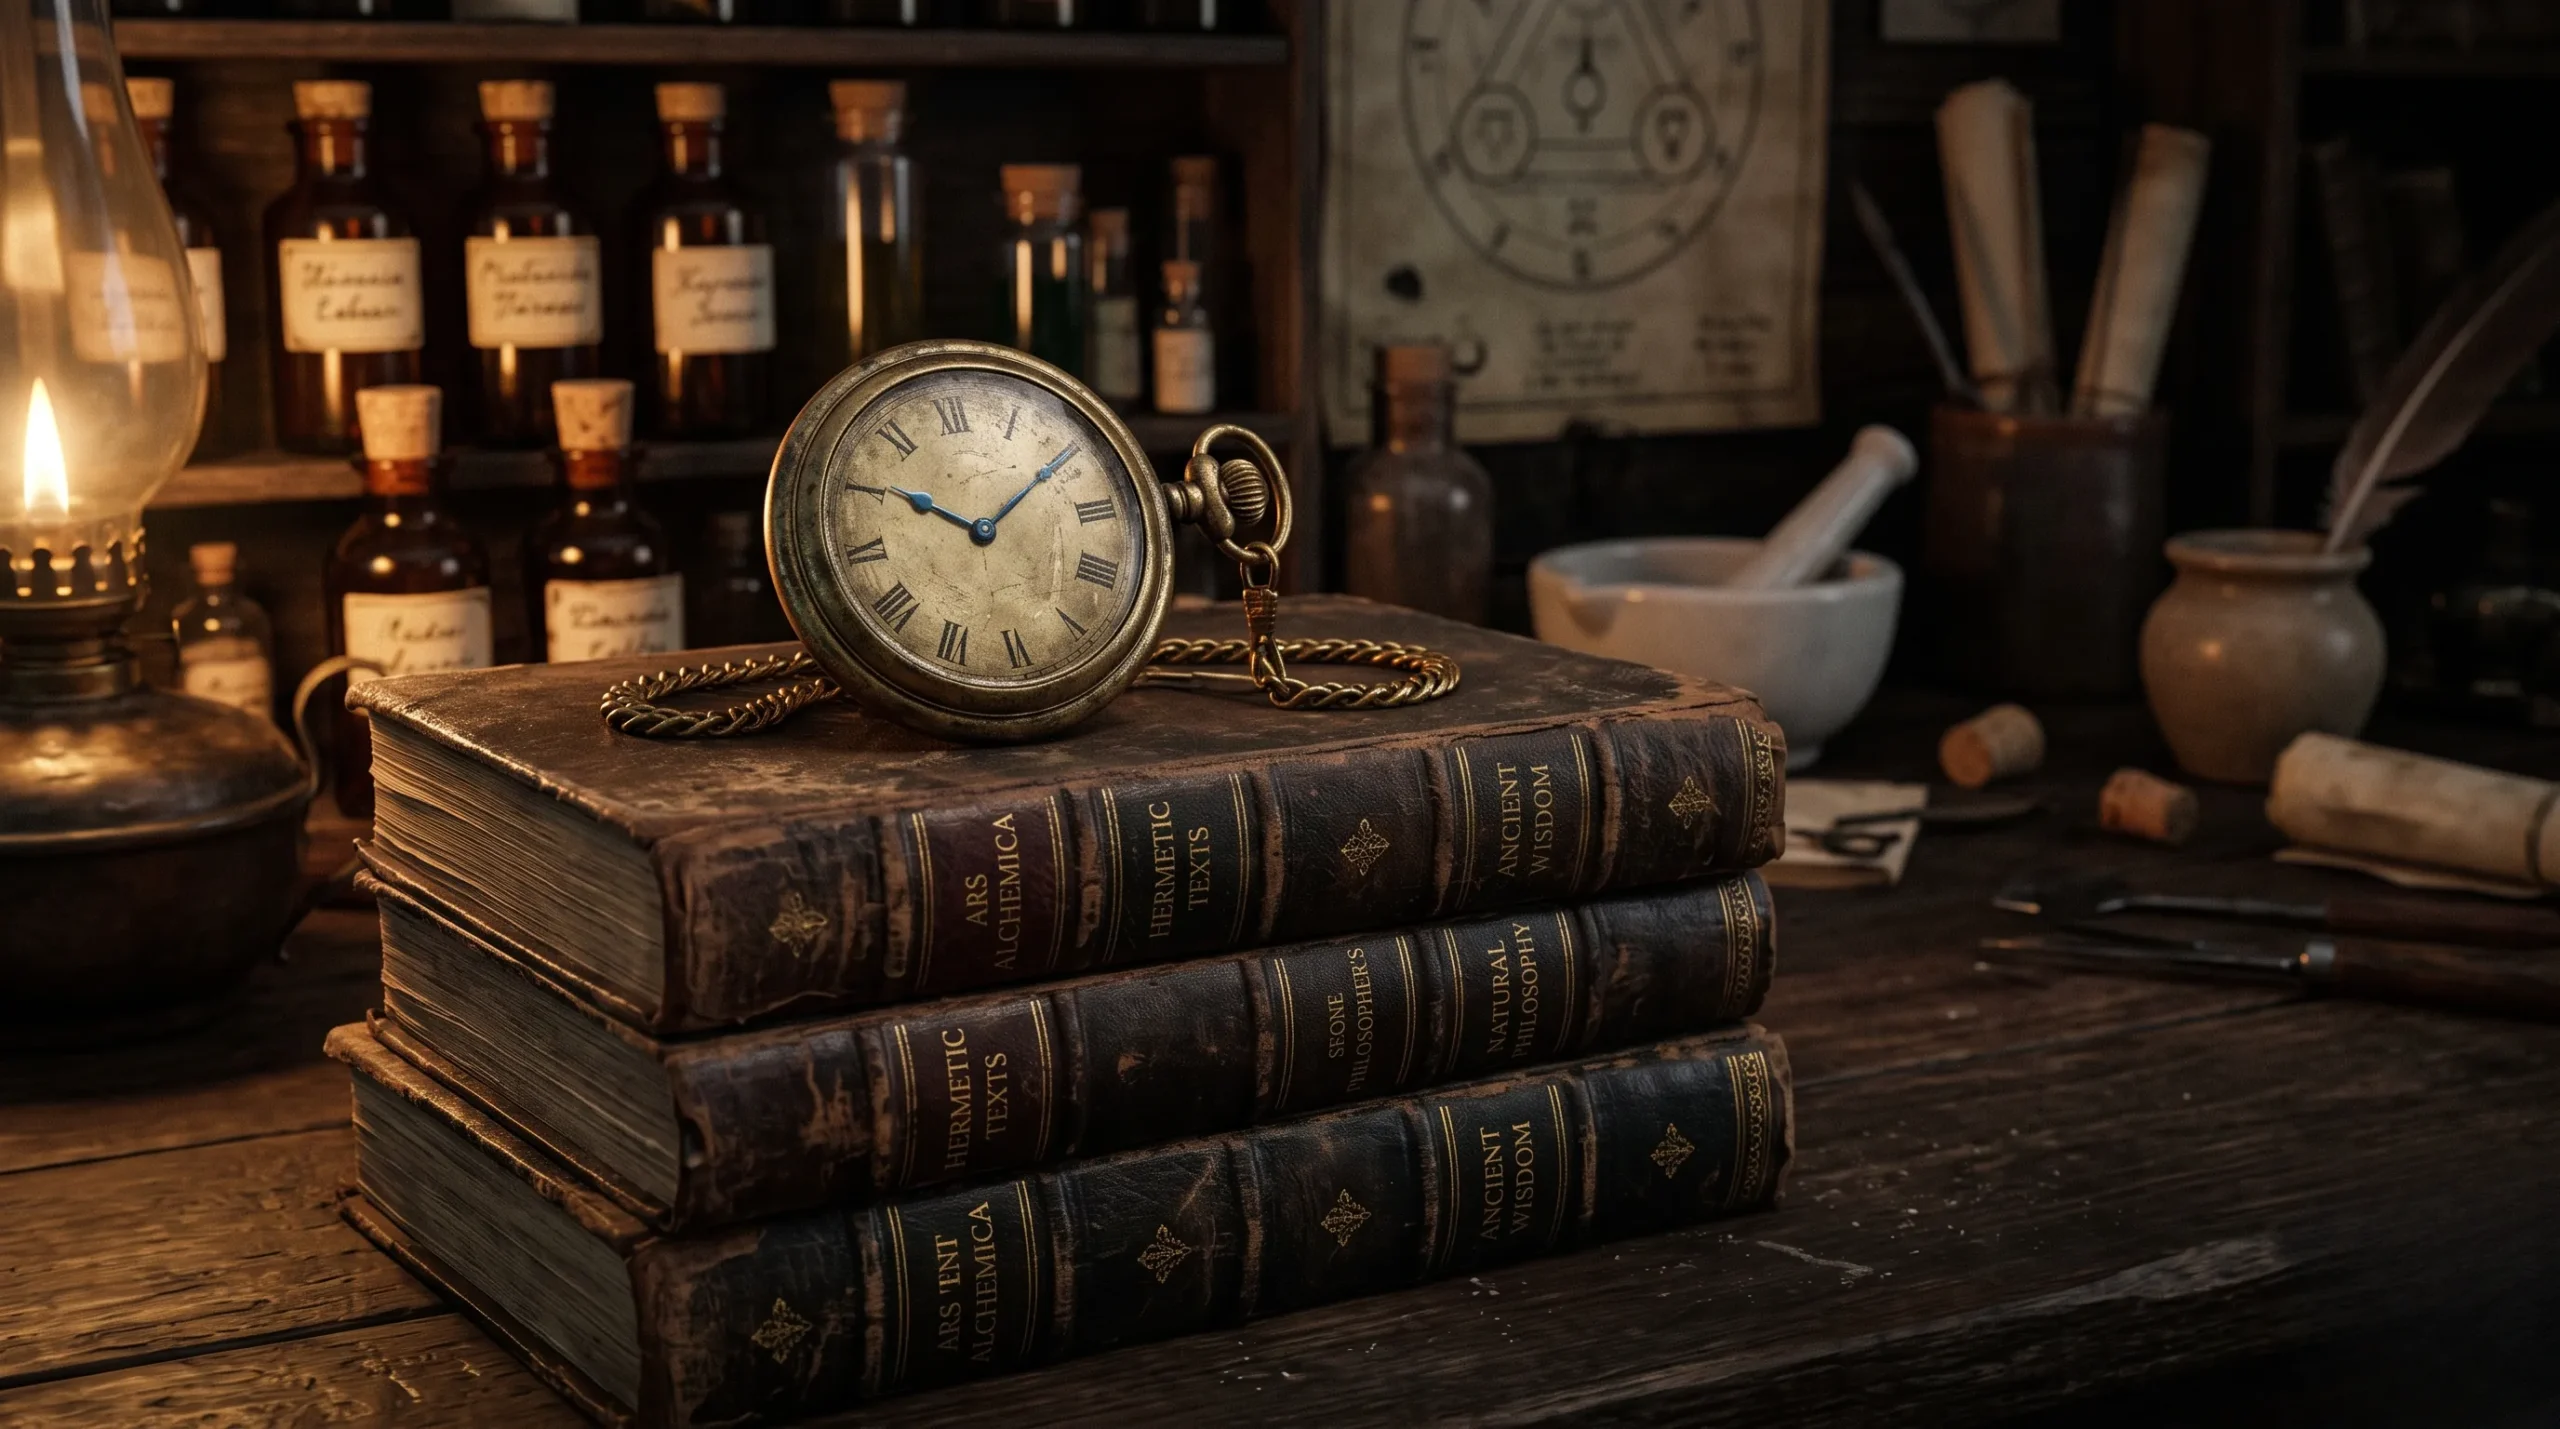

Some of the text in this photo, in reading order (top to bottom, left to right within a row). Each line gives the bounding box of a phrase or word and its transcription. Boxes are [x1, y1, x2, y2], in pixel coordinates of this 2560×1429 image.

[875, 419, 918, 462] XI
[930, 396, 972, 436] XII
[1003, 404, 1021, 441] I
[844, 476, 887, 506] X
[1074, 495, 1117, 527] III
[844, 535, 889, 567] IX
[1074, 549, 1119, 592] IIII
[871, 580, 920, 634] VIII
[1055, 606, 1090, 642] V
[936, 618, 969, 667] VII
[1001, 627, 1034, 669] VI
[1497, 762, 1522, 878] ANCIENT
[1528, 763, 1553, 877] WISDOM
[964, 873, 989, 928] ARS
[992, 812, 1022, 971] ALCHEMICA
[1147, 801, 1175, 939] HERMETIC
[1187, 826, 1212, 912] TEXTS
[1346, 946, 1374, 1093] PHILOSOPHER'S
[1486, 939, 1511, 1055] NATURAL
[1510, 922, 1539, 1060] PHILOSOPHY
[941, 1027, 971, 1171] HERMETIC
[984, 1053, 1009, 1141] TEXTS
[1479, 1126, 1504, 1241] ANCIENT
[1509, 1119, 1535, 1236] WISDOM
[967, 1200, 998, 1363] ALCHEMICA
[937, 1300, 962, 1352] ARS
